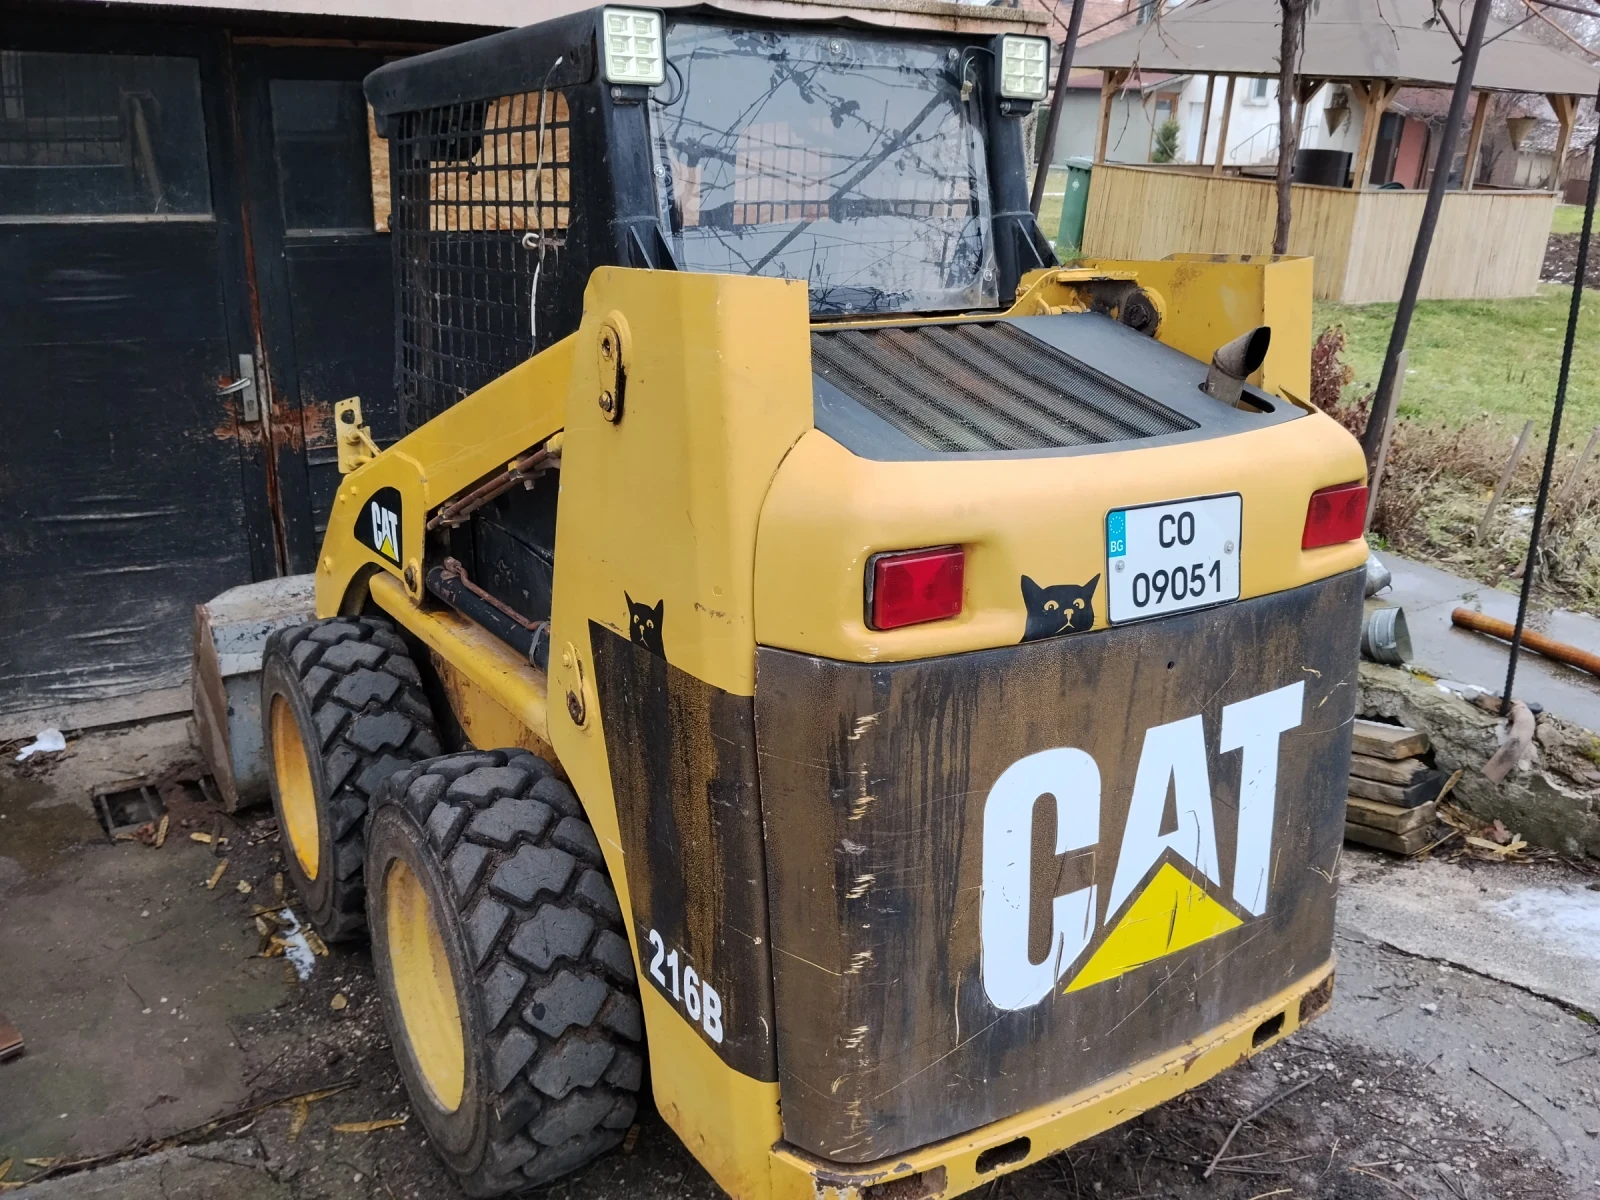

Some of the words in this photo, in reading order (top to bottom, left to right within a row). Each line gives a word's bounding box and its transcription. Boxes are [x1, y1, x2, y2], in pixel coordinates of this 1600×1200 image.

[371, 501, 399, 562] CAT
[1110, 539, 1124, 553] BG
[1159, 511, 1195, 548] CO
[1132, 559, 1221, 607] 09051
[982, 680, 1305, 1010] CAT
[649, 928, 723, 1043] 216B
